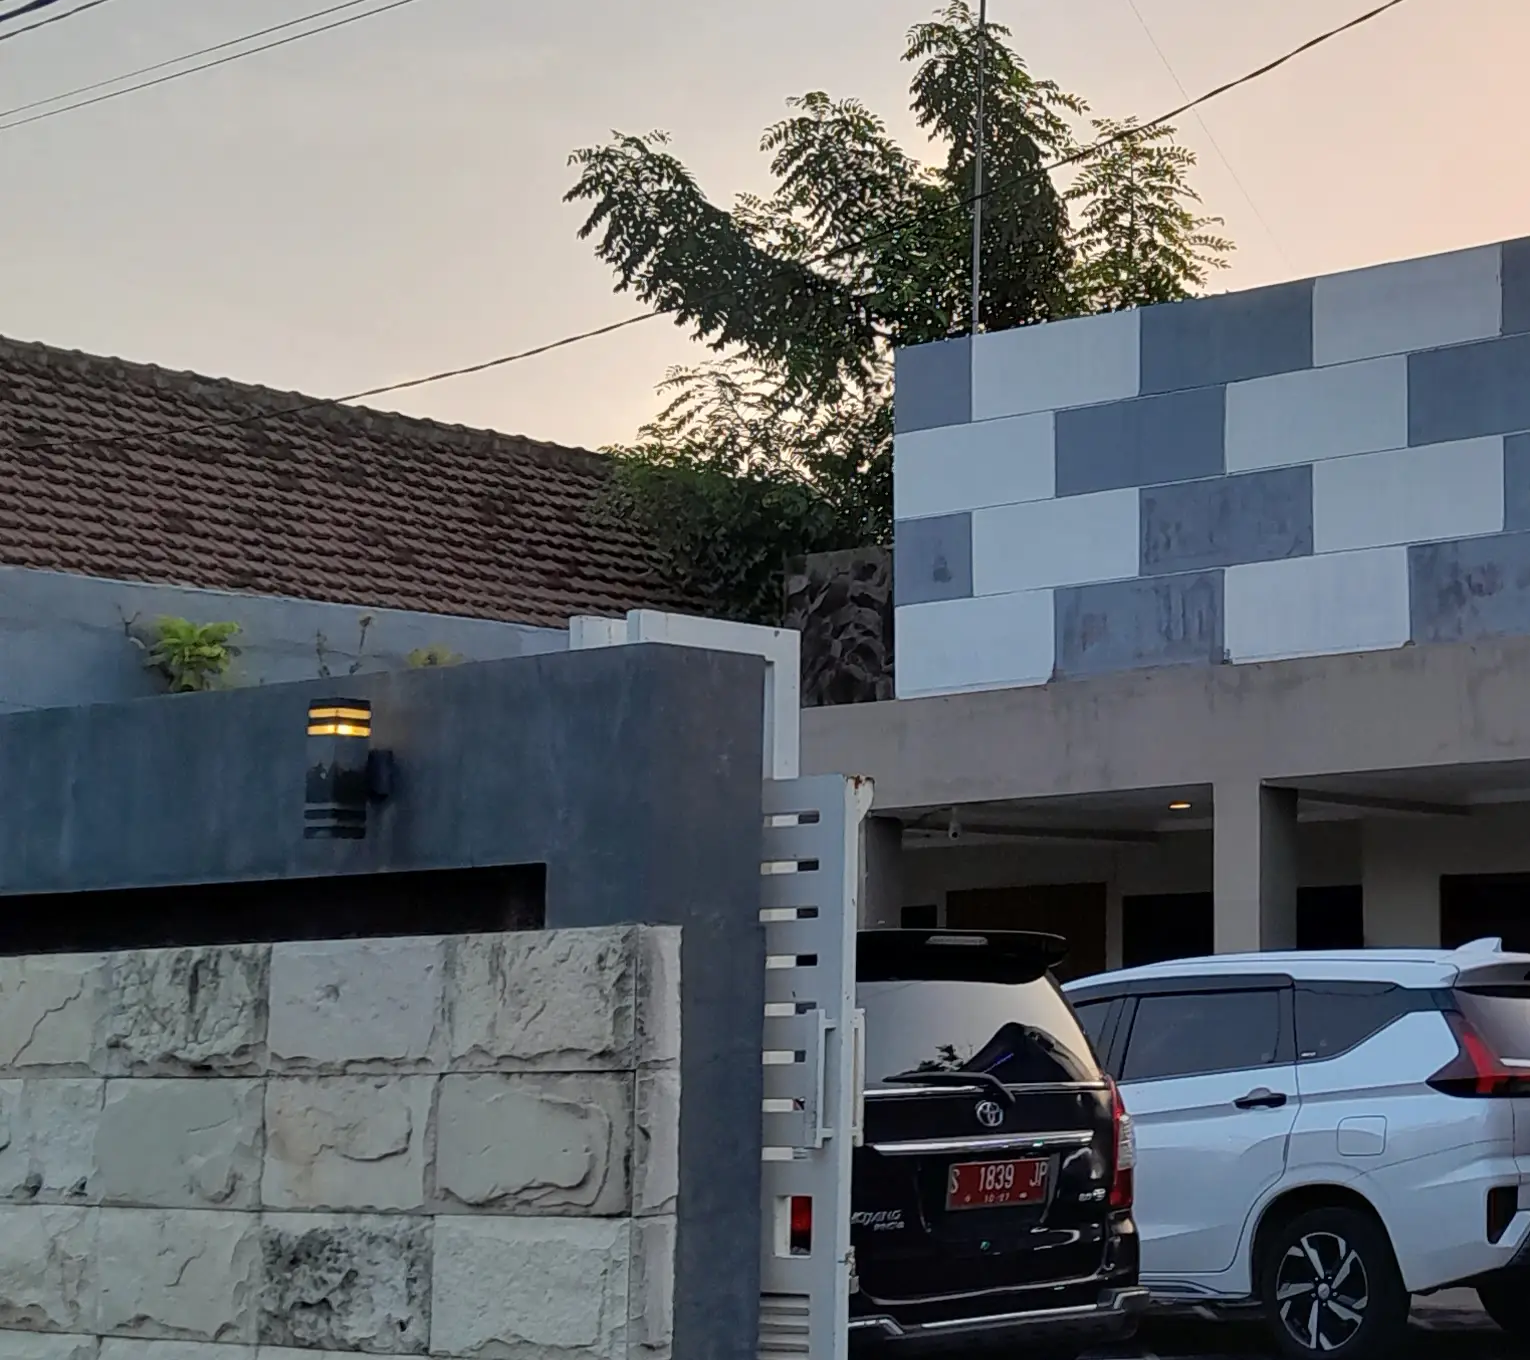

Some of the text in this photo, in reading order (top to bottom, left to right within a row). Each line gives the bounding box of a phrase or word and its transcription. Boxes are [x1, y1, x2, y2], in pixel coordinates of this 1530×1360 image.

[949, 1161, 1049, 1194] S 1839 JP
